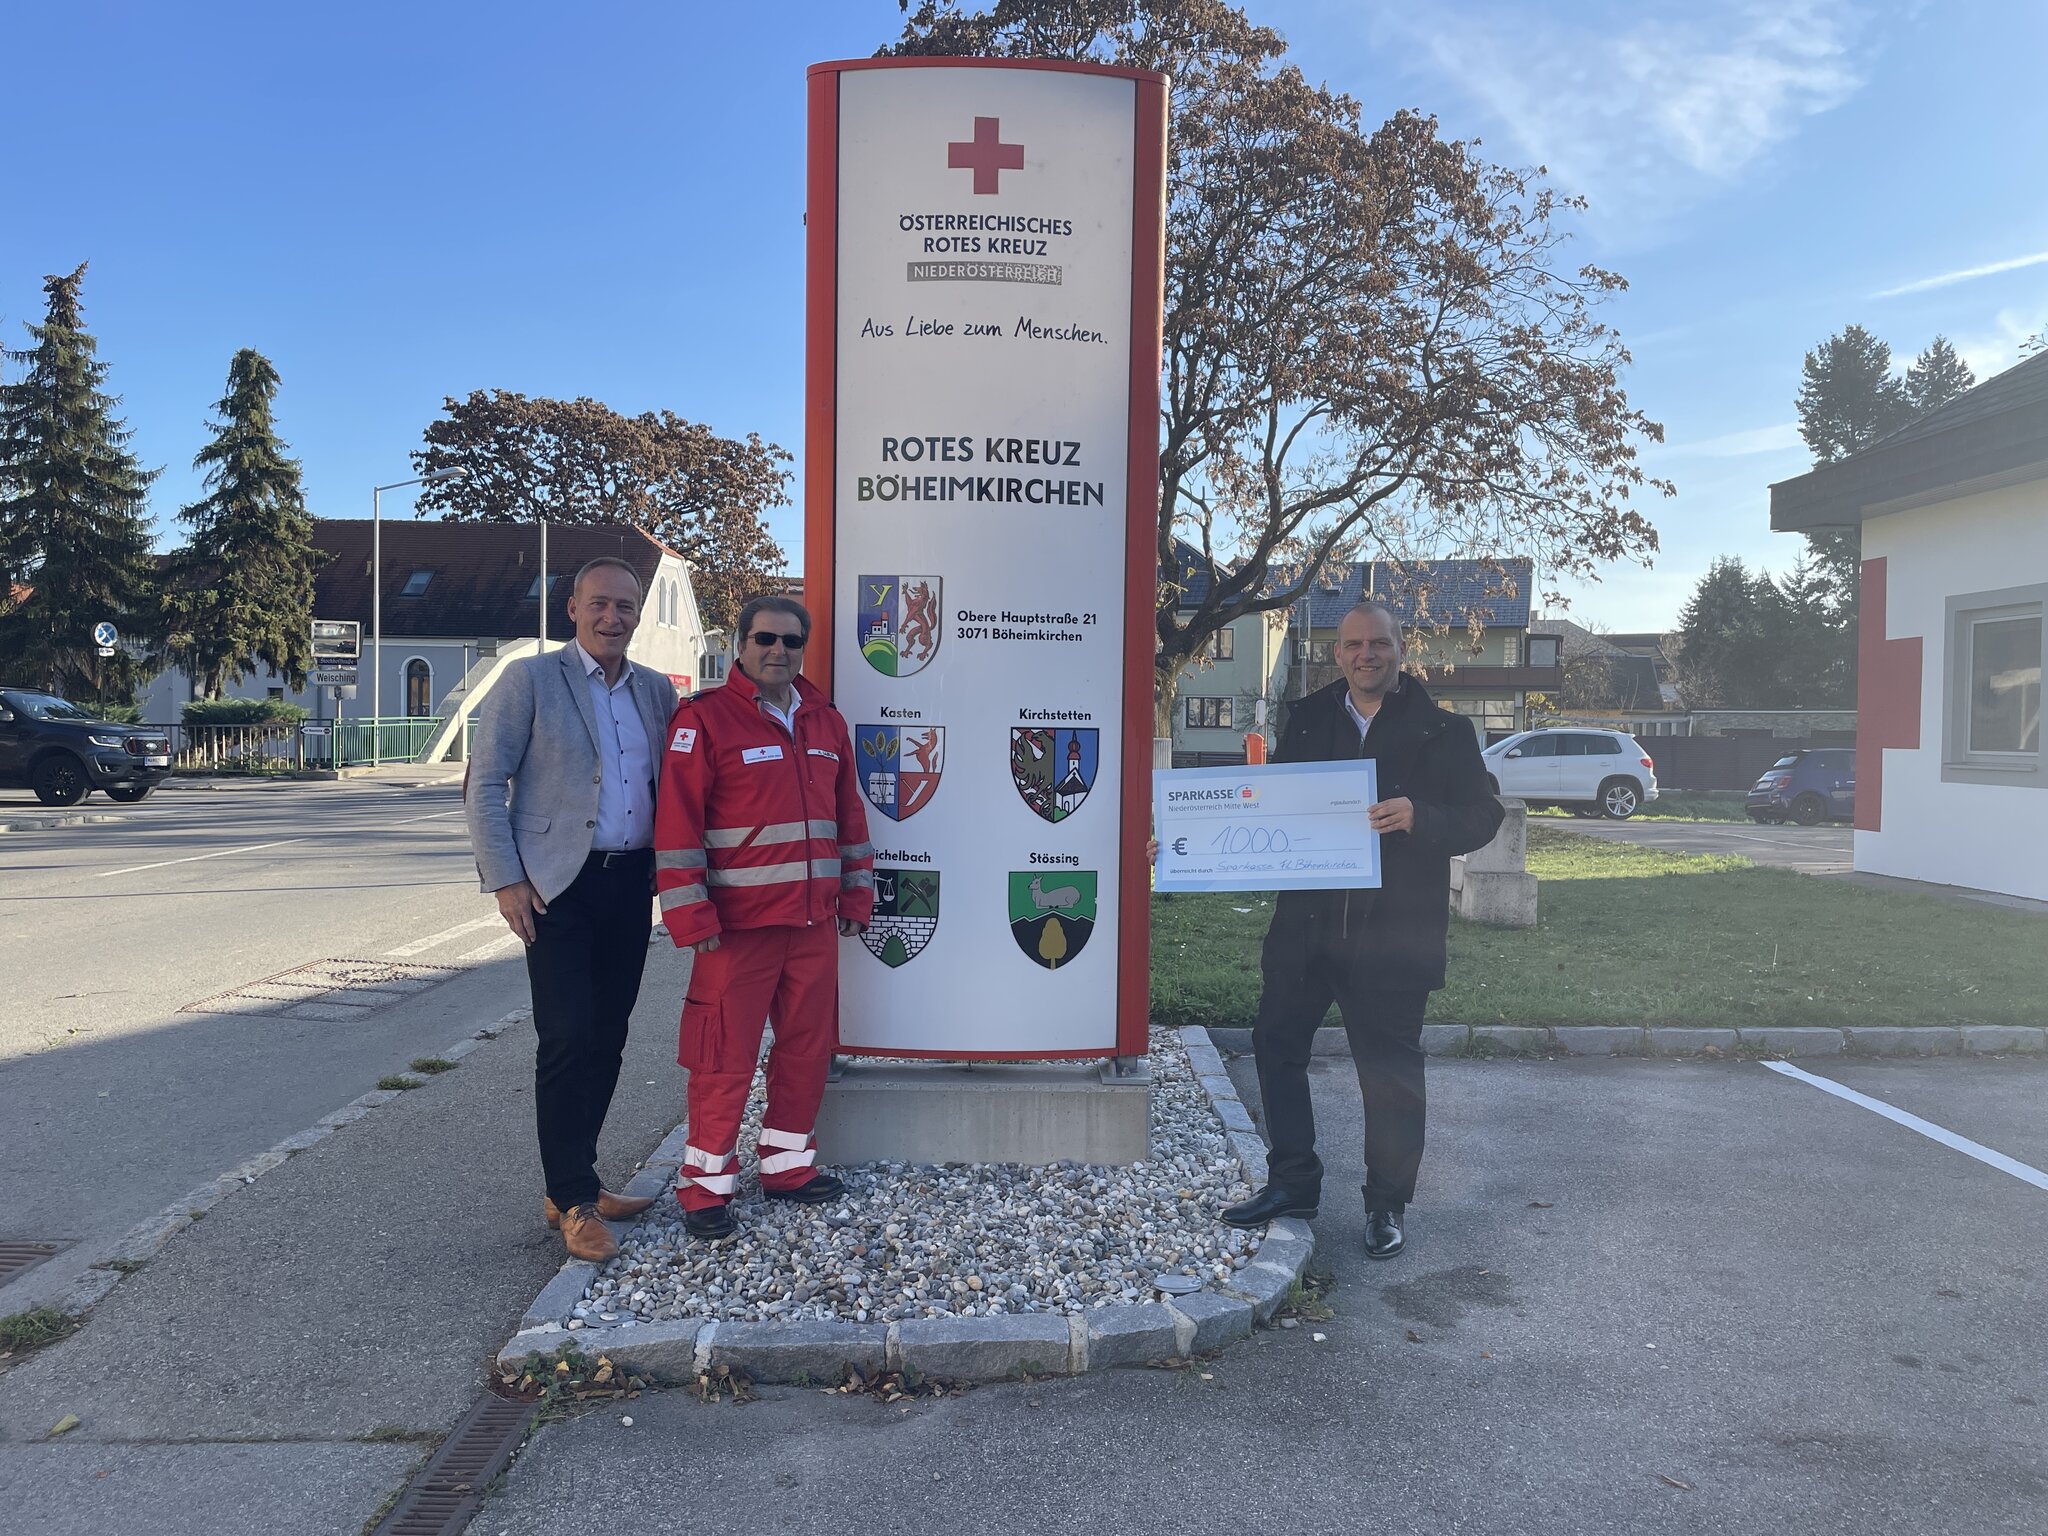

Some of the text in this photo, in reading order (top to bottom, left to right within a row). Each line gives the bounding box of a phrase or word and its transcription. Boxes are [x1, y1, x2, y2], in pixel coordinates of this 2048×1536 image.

[899, 213, 1073, 236] ÖSTERREICHISCHES
[923, 236, 1048, 256] ROTES KREUZ
[913, 262, 1060, 283] NIEDERÖSTERREICH
[861, 316, 1109, 344] Aus Liebe zum Menschen.
[882, 436, 1081, 467] ROTES KREUZ
[857, 473, 1104, 507] BÖHEIMKIRCHEN
[957, 610, 1097, 627] Obere Hauptstraße 21
[957, 627, 1083, 642] 3071 Böheimkirchen
[316, 672, 356, 684] Weisching
[880, 706, 921, 719] Kasten
[1019, 708, 1092, 722] Kirchstetten
[1168, 788, 1234, 802] SPARKASSE
[1168, 801, 1260, 813] Niederösterreich Mitte West
[1171, 837, 1188, 856] €
[873, 848, 931, 863] ichelbach
[1029, 852, 1079, 866] Stössing
